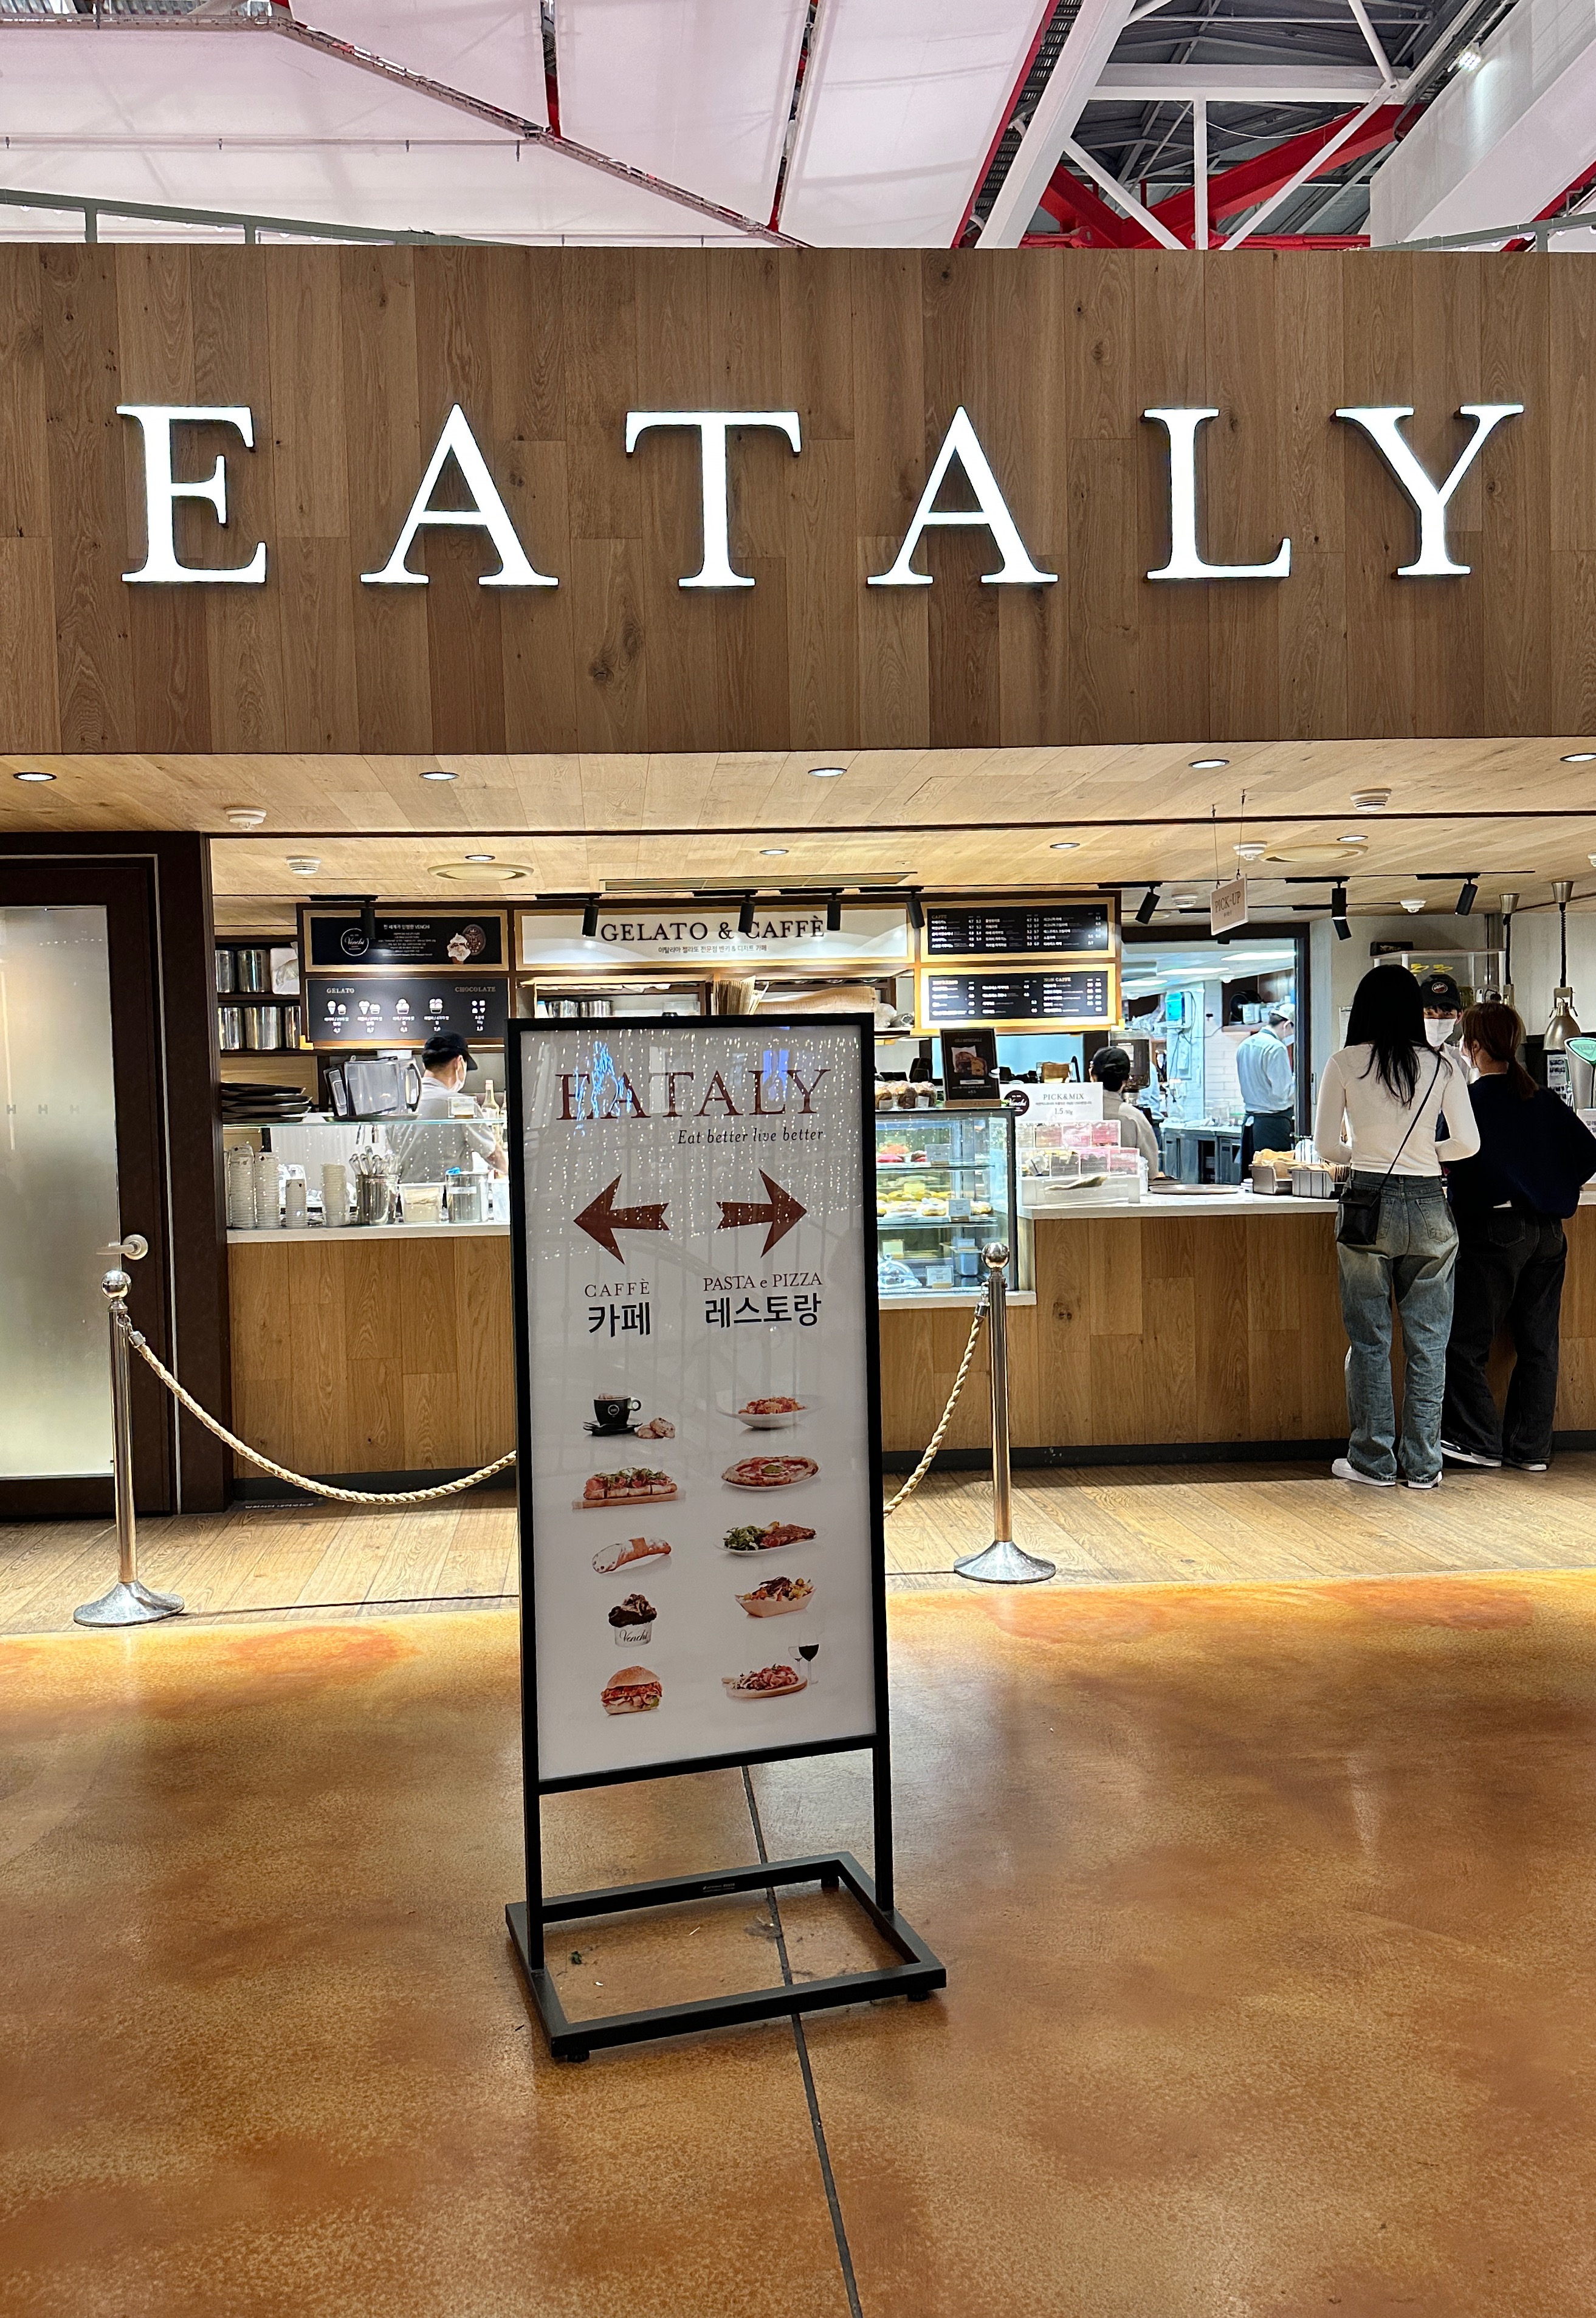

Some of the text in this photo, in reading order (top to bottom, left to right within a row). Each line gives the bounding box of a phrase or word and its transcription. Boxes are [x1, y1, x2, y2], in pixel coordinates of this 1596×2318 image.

[115, 404, 1524, 588] EATALY
[1214, 891, 1241, 913] PICK-UP
[601, 915, 824, 941] GELATO & CAFFÈ
[345, 937, 365, 946] Venchi
[556, 1068, 831, 1120] EATALY
[678, 1127, 824, 1144] Eat better live better
[584, 1278, 650, 1298] CAFFÈ
[703, 1272, 823, 1291] PASTA e PIZZA
[588, 1301, 651, 1338] 카페
[705, 1292, 822, 1329] 레스토랑
[619, 1629, 648, 1642] Venchi
